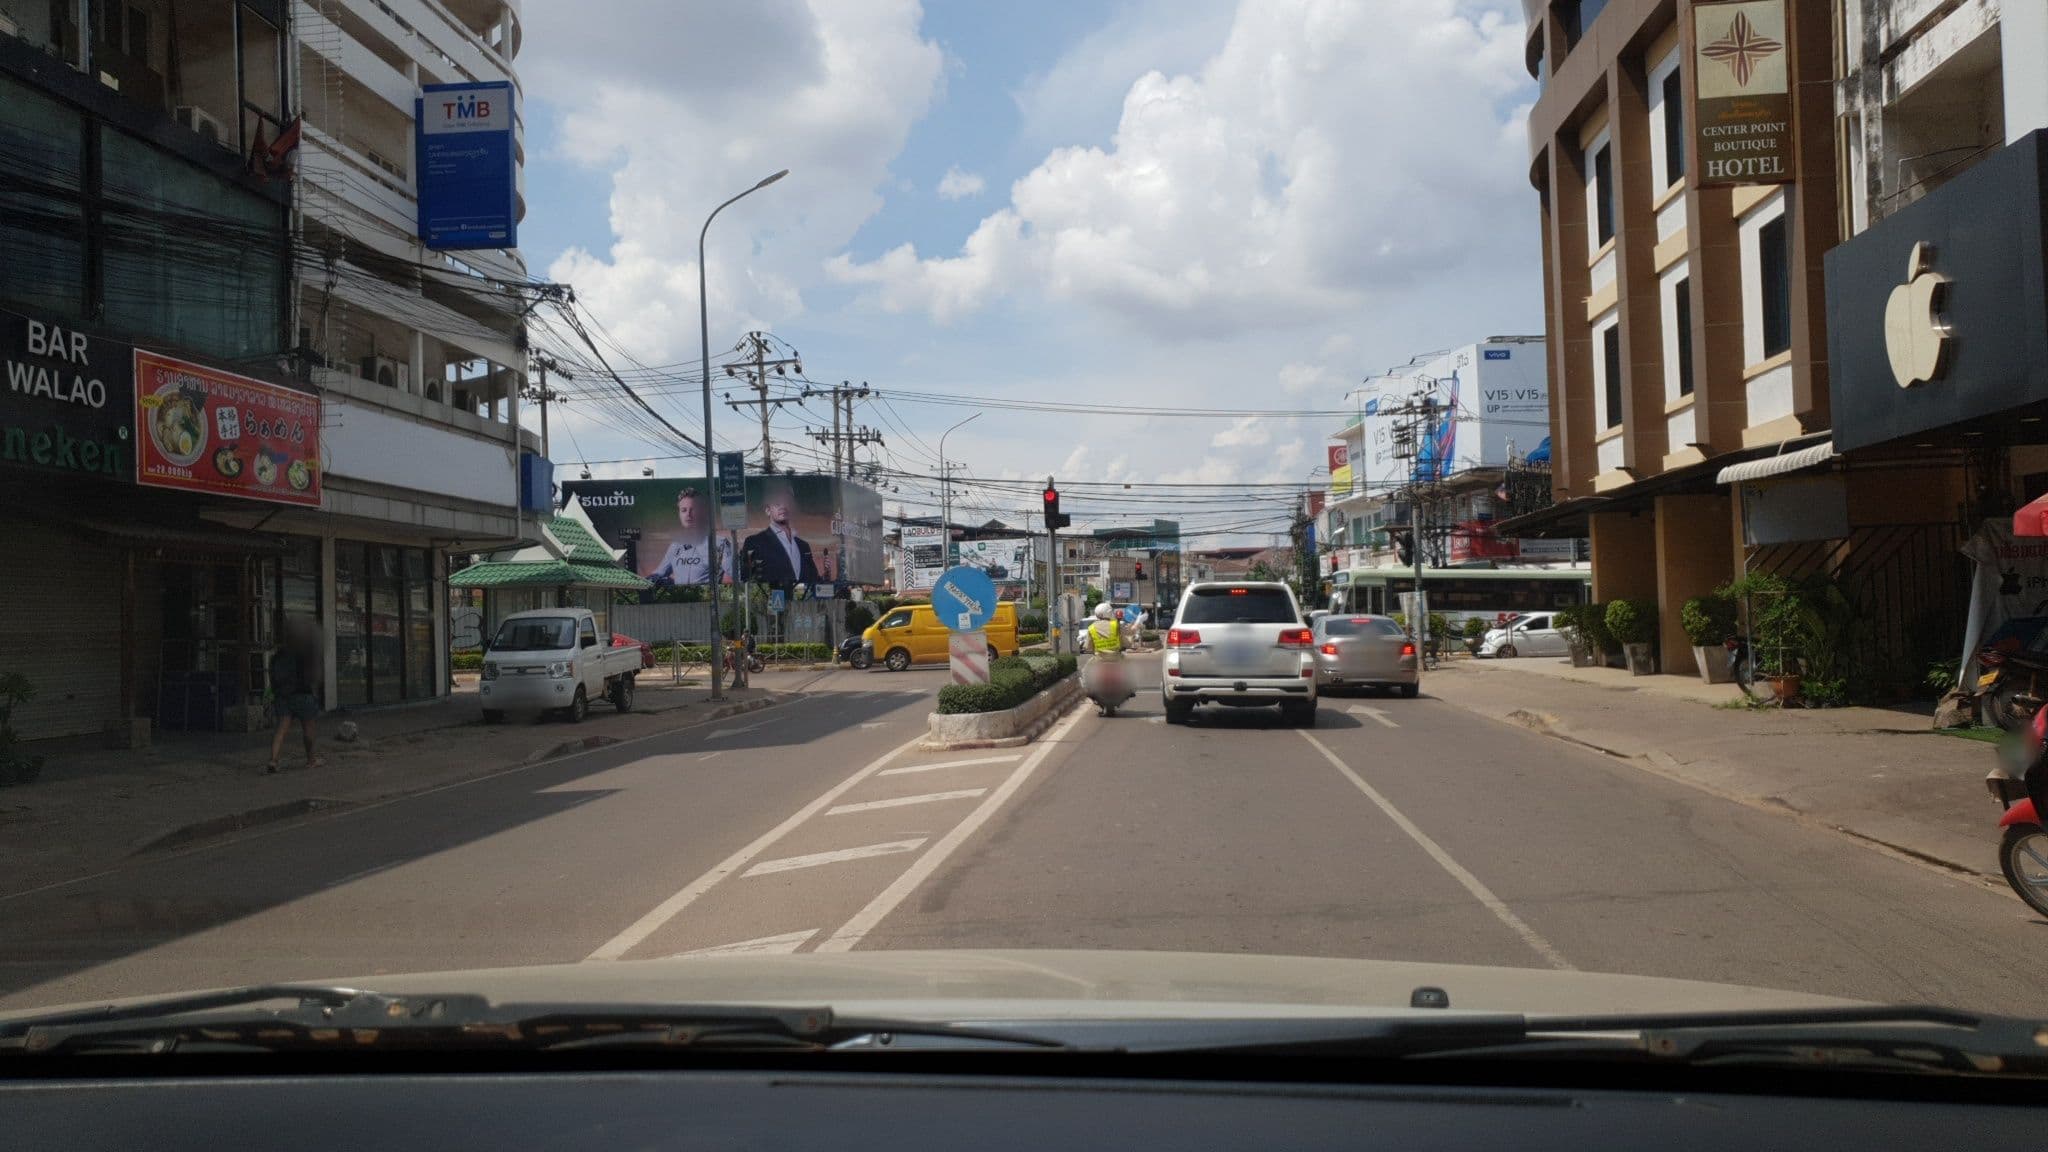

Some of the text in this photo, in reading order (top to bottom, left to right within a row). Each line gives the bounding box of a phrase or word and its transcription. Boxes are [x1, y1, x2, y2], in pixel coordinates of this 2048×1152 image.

[443, 96, 490, 119] TMB
[1703, 122, 1786, 137] CENTER POINT
[1714, 138, 1776, 152] BOUTIQUE
[1707, 156, 1785, 177] HOTEL
[28, 319, 89, 366] BAR
[7, 360, 106, 409] WALAO
[1484, 389, 1509, 401] V15
[1515, 388, 1539, 400] V15
[1487, 404, 1501, 413] UP
